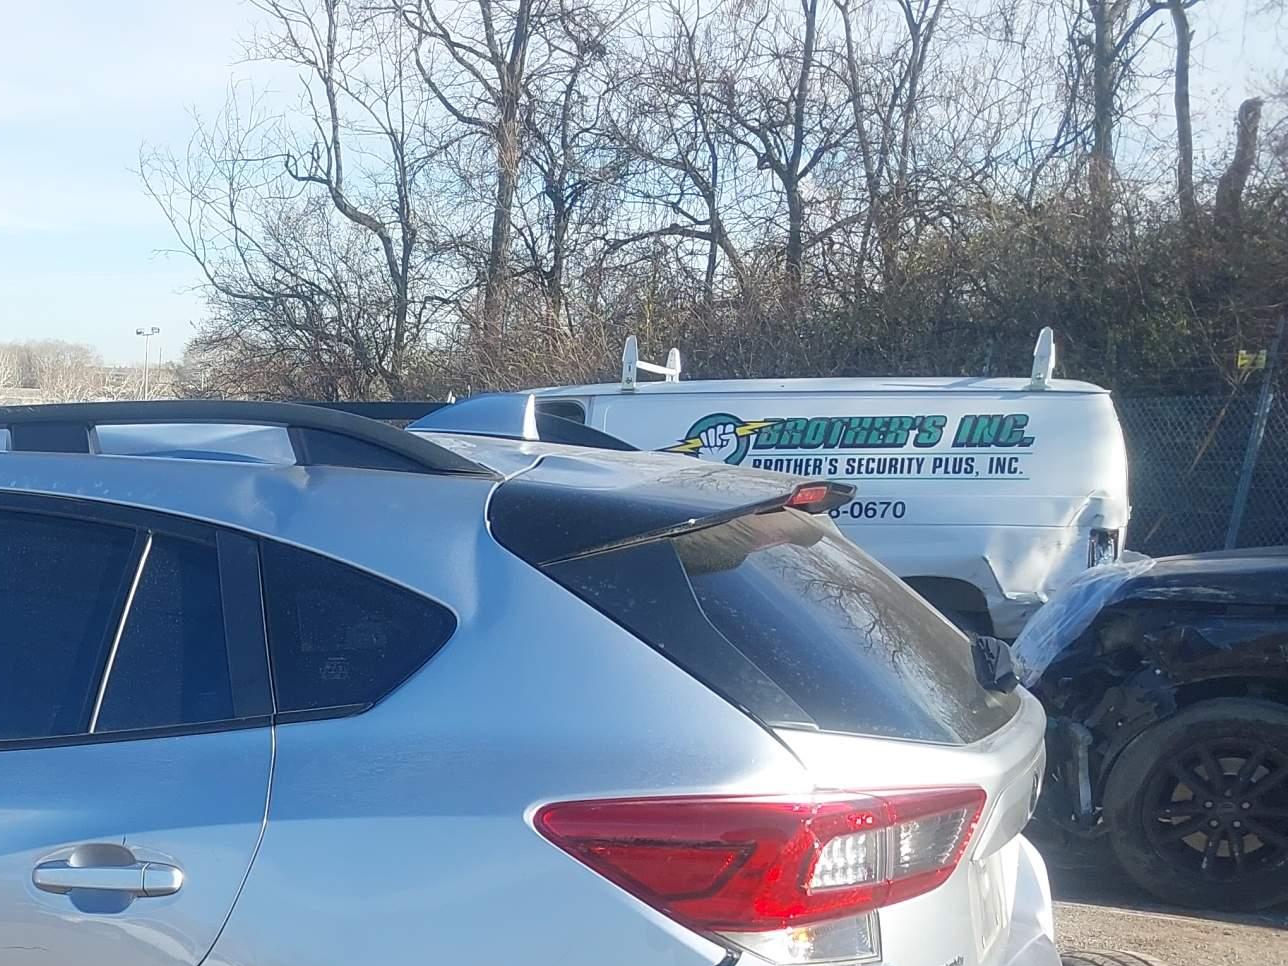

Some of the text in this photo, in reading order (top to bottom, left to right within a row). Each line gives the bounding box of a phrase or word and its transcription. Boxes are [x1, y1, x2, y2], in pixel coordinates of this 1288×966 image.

[754, 414, 1034, 449] BROTHER'S INC.
[752, 456, 1023, 477] BROTHER'S SECURITY PLUS, INC.
